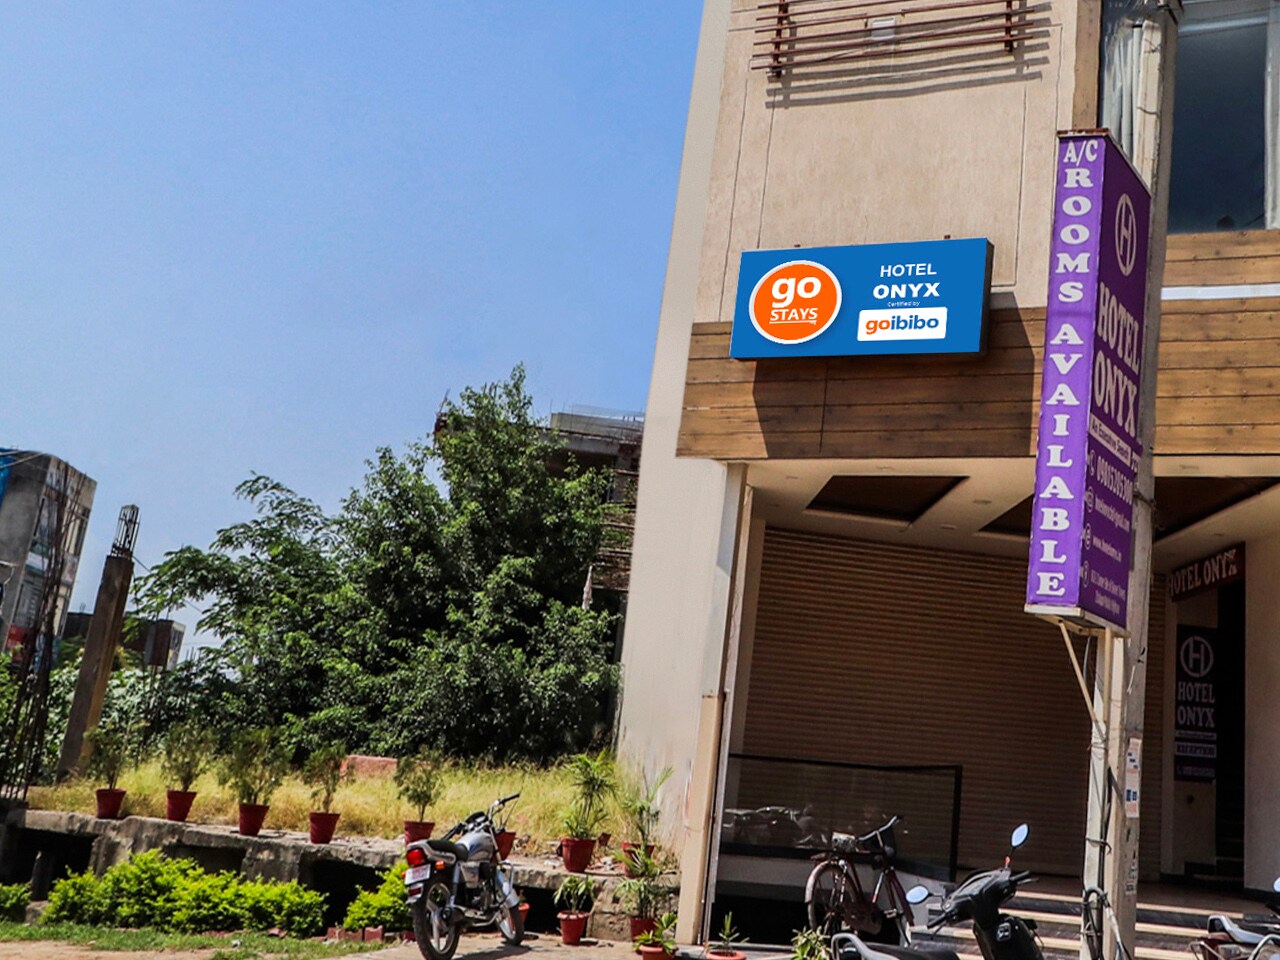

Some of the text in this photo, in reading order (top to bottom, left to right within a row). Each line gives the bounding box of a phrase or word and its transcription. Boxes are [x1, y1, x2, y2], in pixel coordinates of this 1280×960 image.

[1064, 139, 1098, 166] A/C
[1055, 168, 1094, 303] ROOMS
[880, 263, 937, 278] HOTEL
[771, 275, 822, 309] go
[873, 282, 940, 299] ONYX
[769, 307, 818, 322] STAYS
[865, 315, 939, 335] goibibo
[1097, 281, 1140, 376] HOTEL
[1093, 350, 1139, 438] ONYX
[1036, 323, 1084, 597] AVAILABLE
[1178, 681, 1216, 704] HOTEL
[1177, 705, 1216, 728] ONYX
